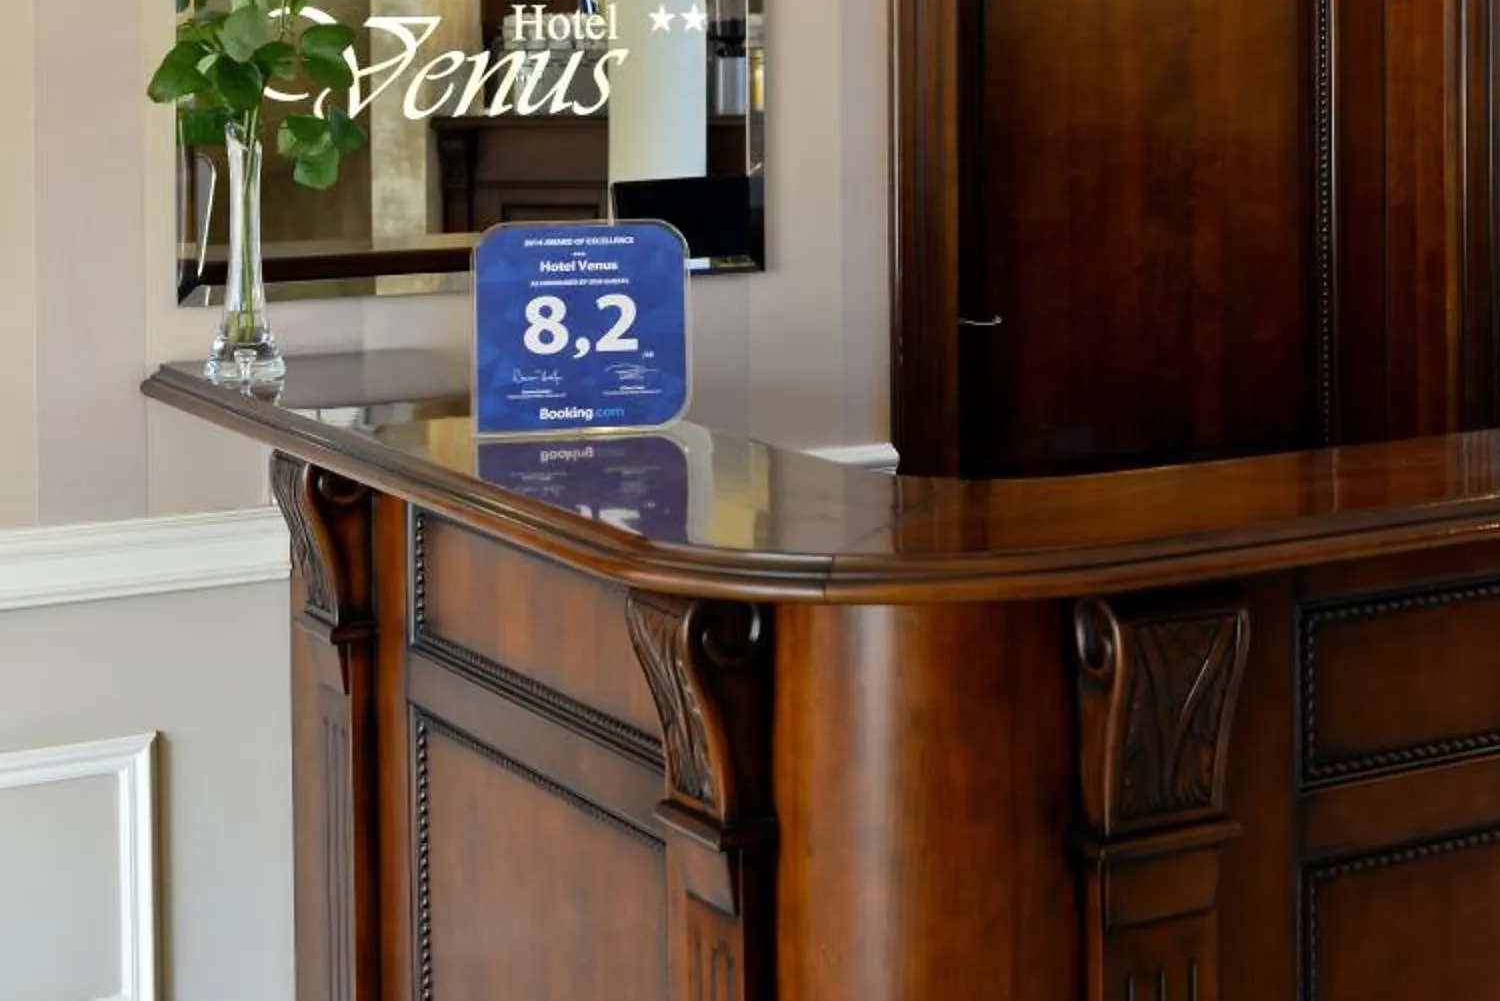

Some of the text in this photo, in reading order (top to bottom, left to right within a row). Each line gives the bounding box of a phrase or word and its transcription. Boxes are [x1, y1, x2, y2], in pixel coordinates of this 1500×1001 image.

[511, 3, 618, 42] Hotel
[263, 7, 630, 121] Venus
[543, 238, 572, 247] AWARD
[574, 237, 584, 246] OF
[586, 236, 635, 246] EXCELLENCE
[539, 260, 618, 272] Hotel Venus
[523, 292, 639, 360] 8,2
[539, 406, 625, 421] Booking.com
